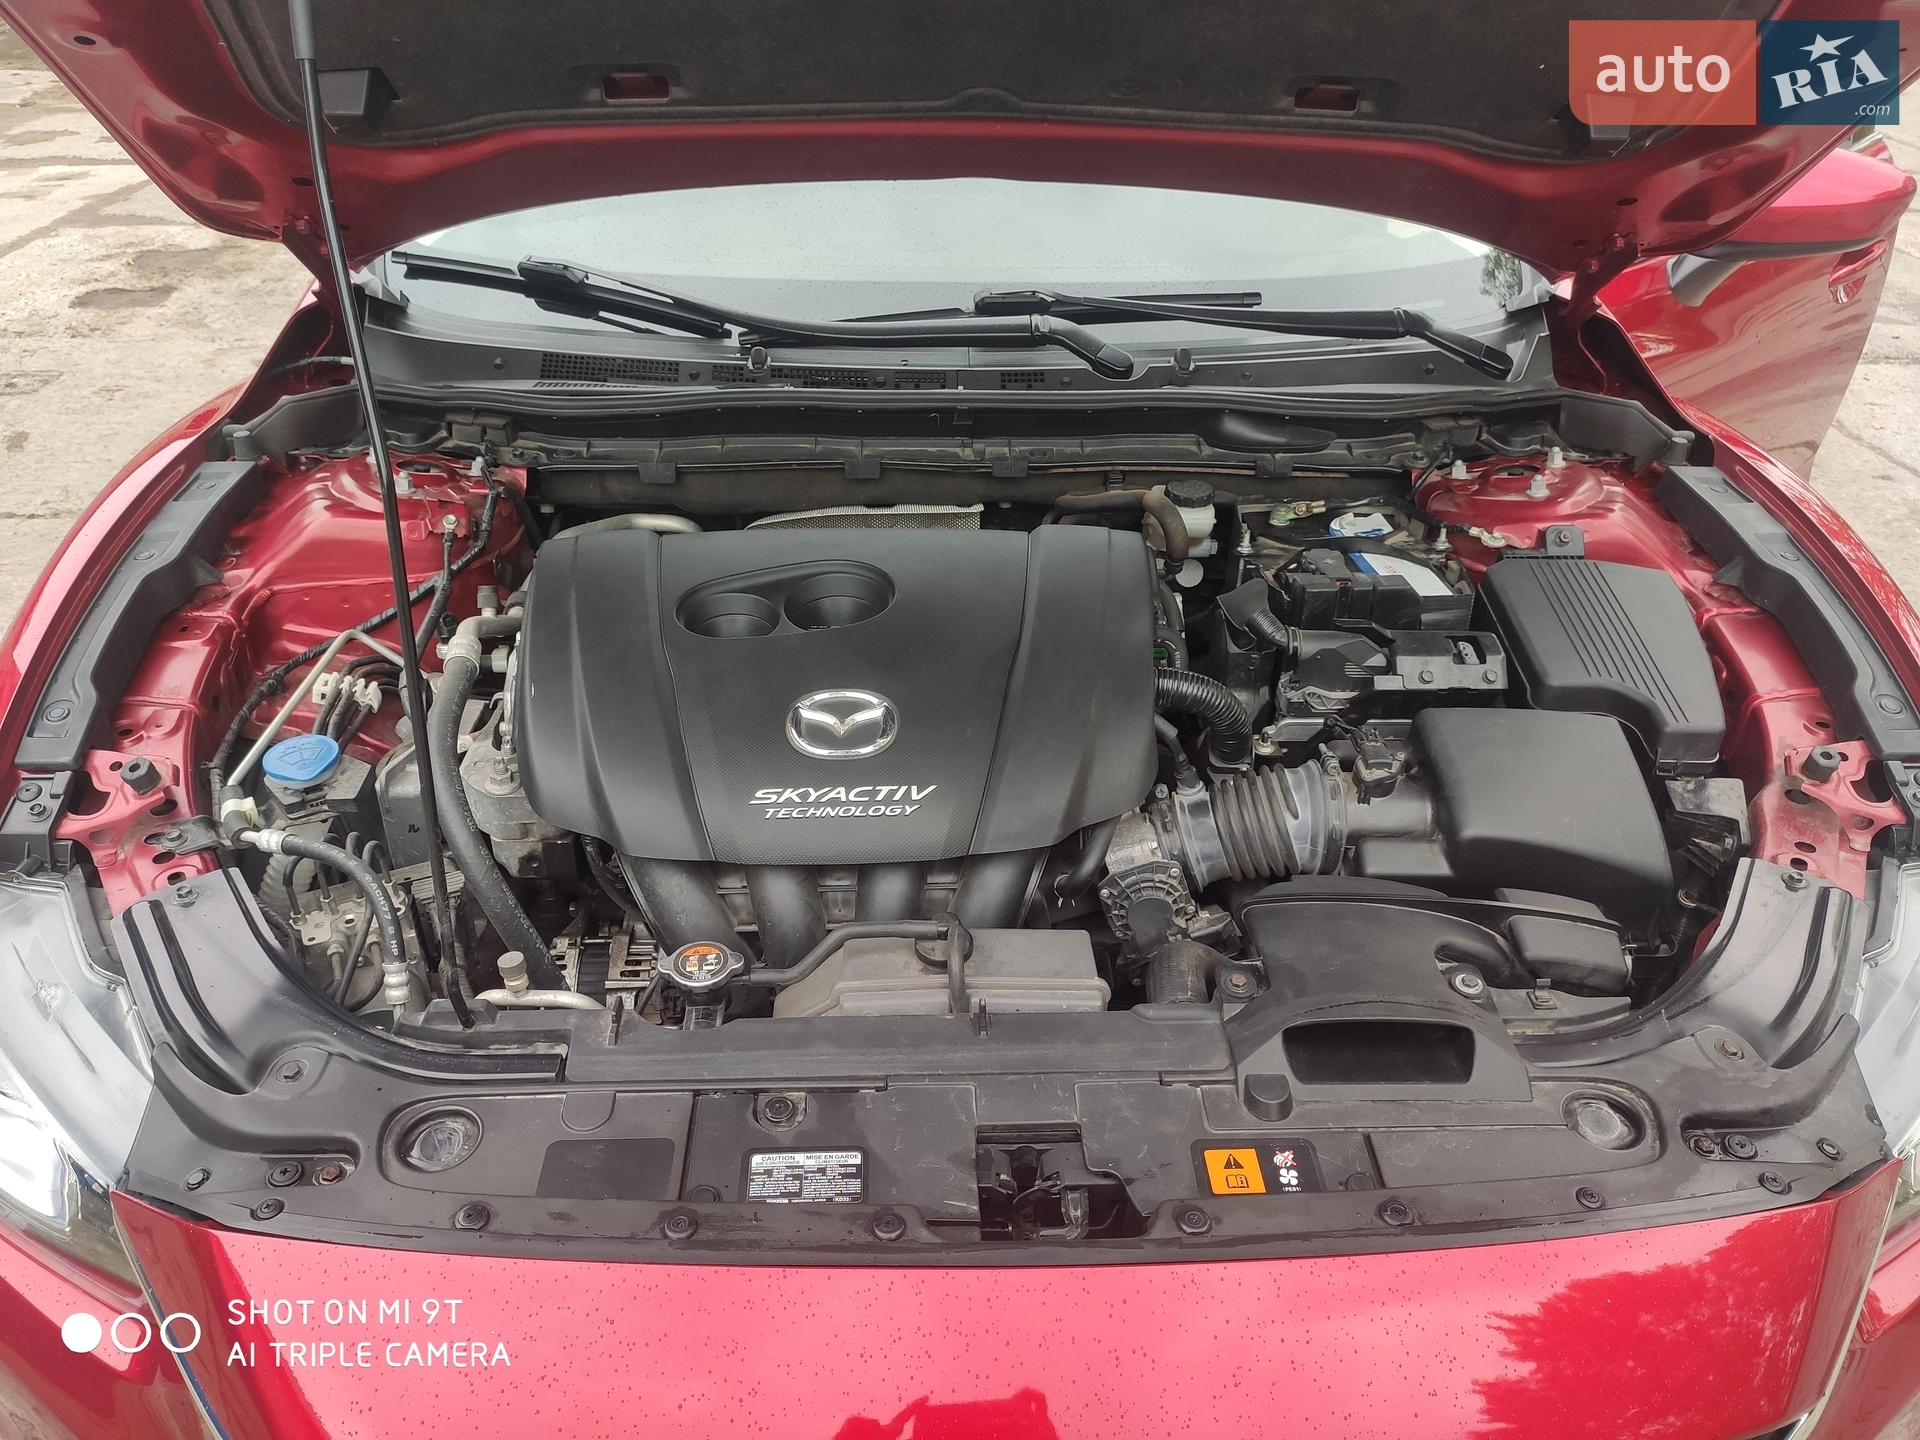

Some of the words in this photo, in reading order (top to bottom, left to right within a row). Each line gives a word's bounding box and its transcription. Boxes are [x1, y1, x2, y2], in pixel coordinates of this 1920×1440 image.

[748, 785, 938, 805] SKYACTIV
[764, 804, 921, 820] TECHNOLOGY
[390, 940, 399, 956] HP
